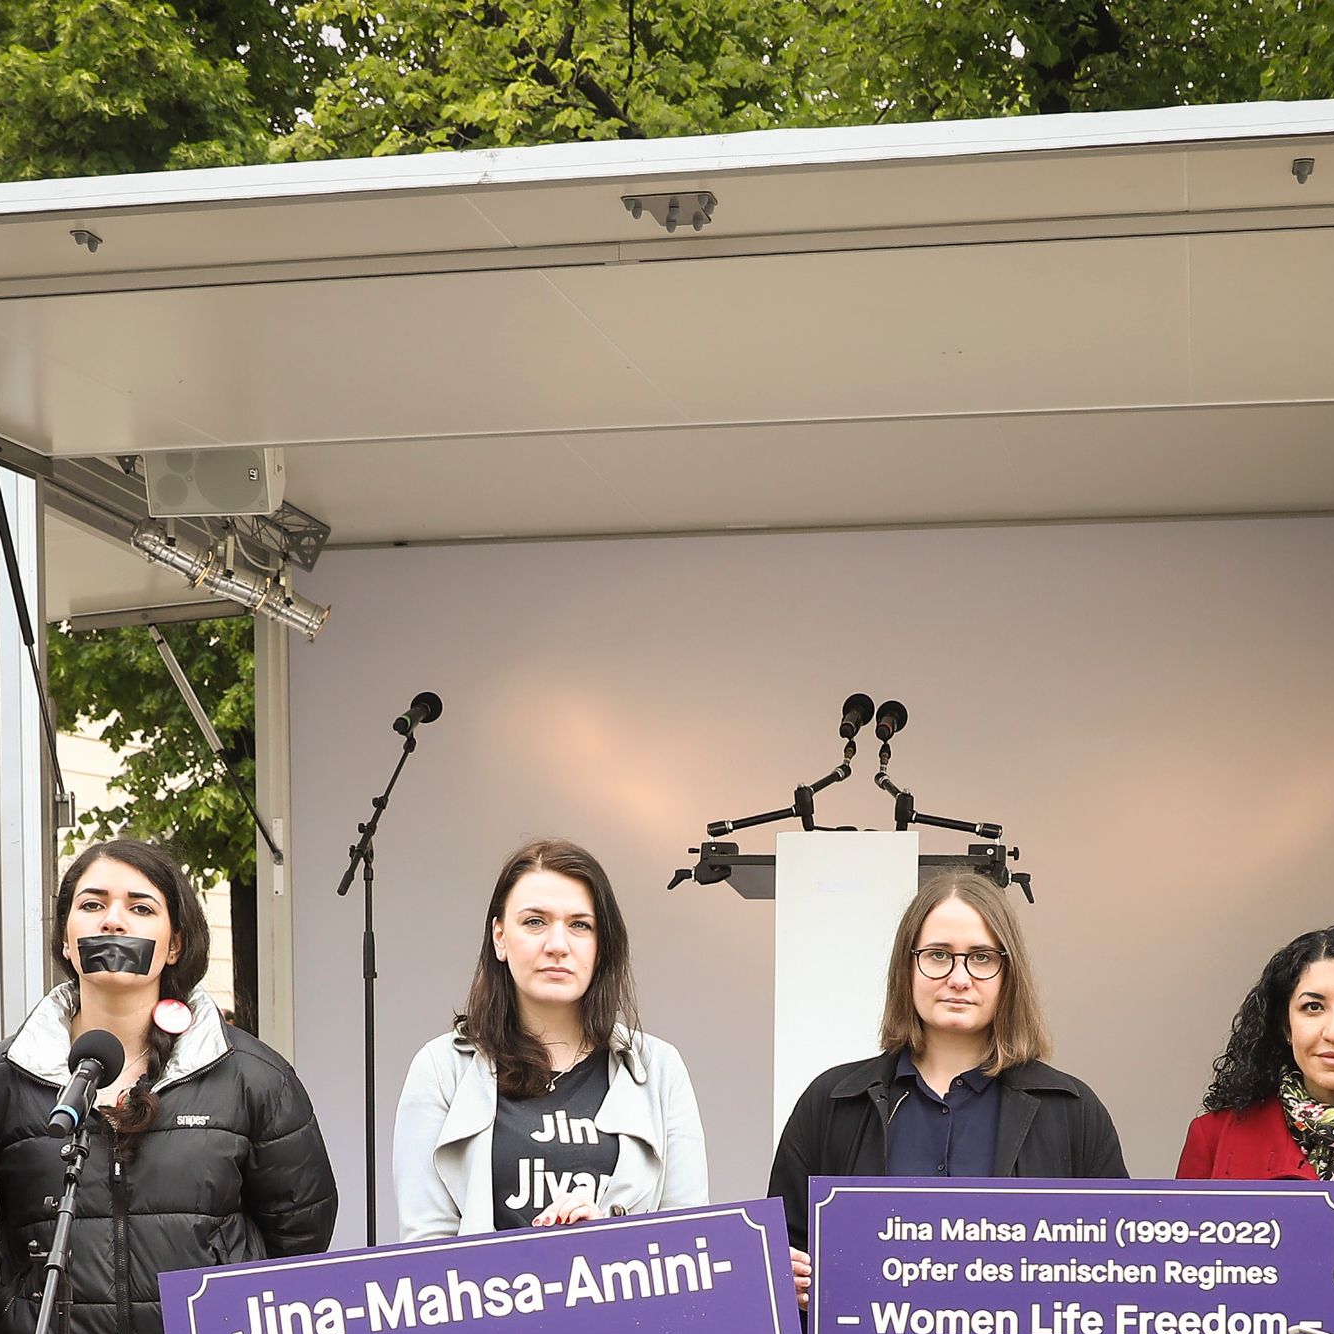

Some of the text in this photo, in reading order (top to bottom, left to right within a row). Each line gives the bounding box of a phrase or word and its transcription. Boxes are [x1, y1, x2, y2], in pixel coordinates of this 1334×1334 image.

[530, 1110, 600, 1145] Jin
[877, 1216, 1281, 1249] Jina Mahsa Amini (1999-2022)
[882, 1255, 1278, 1291] Opfer des iranischen Regimes
